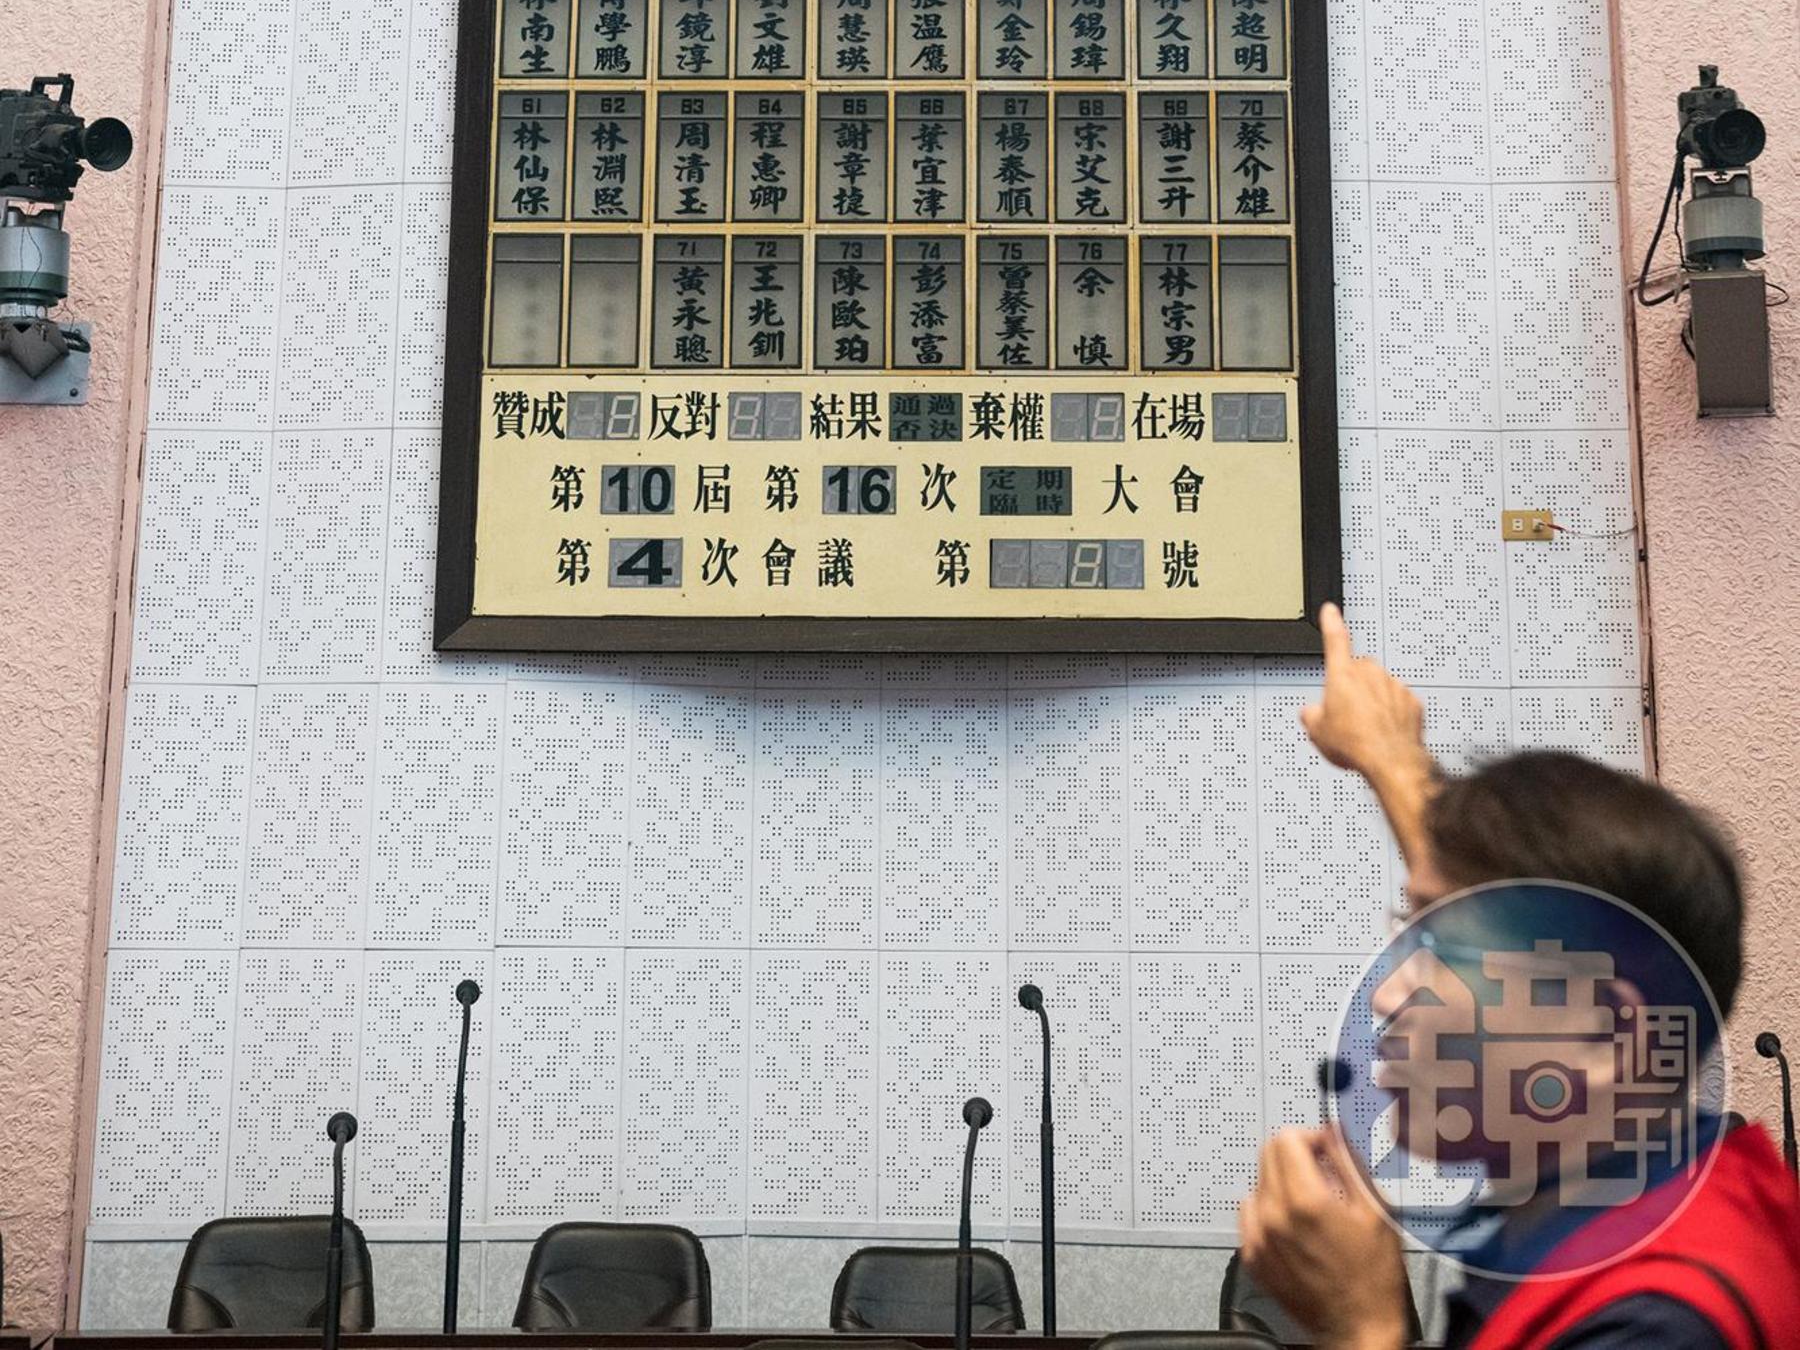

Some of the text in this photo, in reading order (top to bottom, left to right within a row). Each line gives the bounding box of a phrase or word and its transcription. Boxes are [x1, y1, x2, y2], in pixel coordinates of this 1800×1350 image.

[1239, 99, 1264, 116] 70
[674, 122, 710, 215] 周清玉
[749, 122, 787, 215] 程惠卿
[912, 121, 948, 219] 葉宜津
[993, 123, 1035, 219] 楊泰順
[1071, 122, 1111, 217] 宋艾克
[1233, 122, 1275, 218] 蔡介雄
[677, 241, 697, 258] 71
[754, 241, 778, 258] 72
[838, 241, 864, 258] 73
[917, 241, 941, 260] 74
[998, 241, 1023, 260] 75
[1077, 241, 1103, 260] 76
[1162, 241, 1188, 260] 77
[748, 265, 785, 361] 王兆釧
[832, 266, 870, 363] 陳歐珀
[910, 265, 948, 366] 彭添富
[1073, 267, 1114, 366] 余慎
[1159, 265, 1197, 366] 林宗男
[492, 391, 566, 440] 贊成
[648, 391, 720, 440] 反對
[810, 391, 882, 440] 結果
[893, 394, 957, 416] 通過
[895, 418, 959, 440] 否決
[968, 392, 1044, 441] 棄權
[1132, 392, 1205, 441] 在場
[987, 470, 1063, 491] 定期
[988, 493, 1063, 514] 臨時
